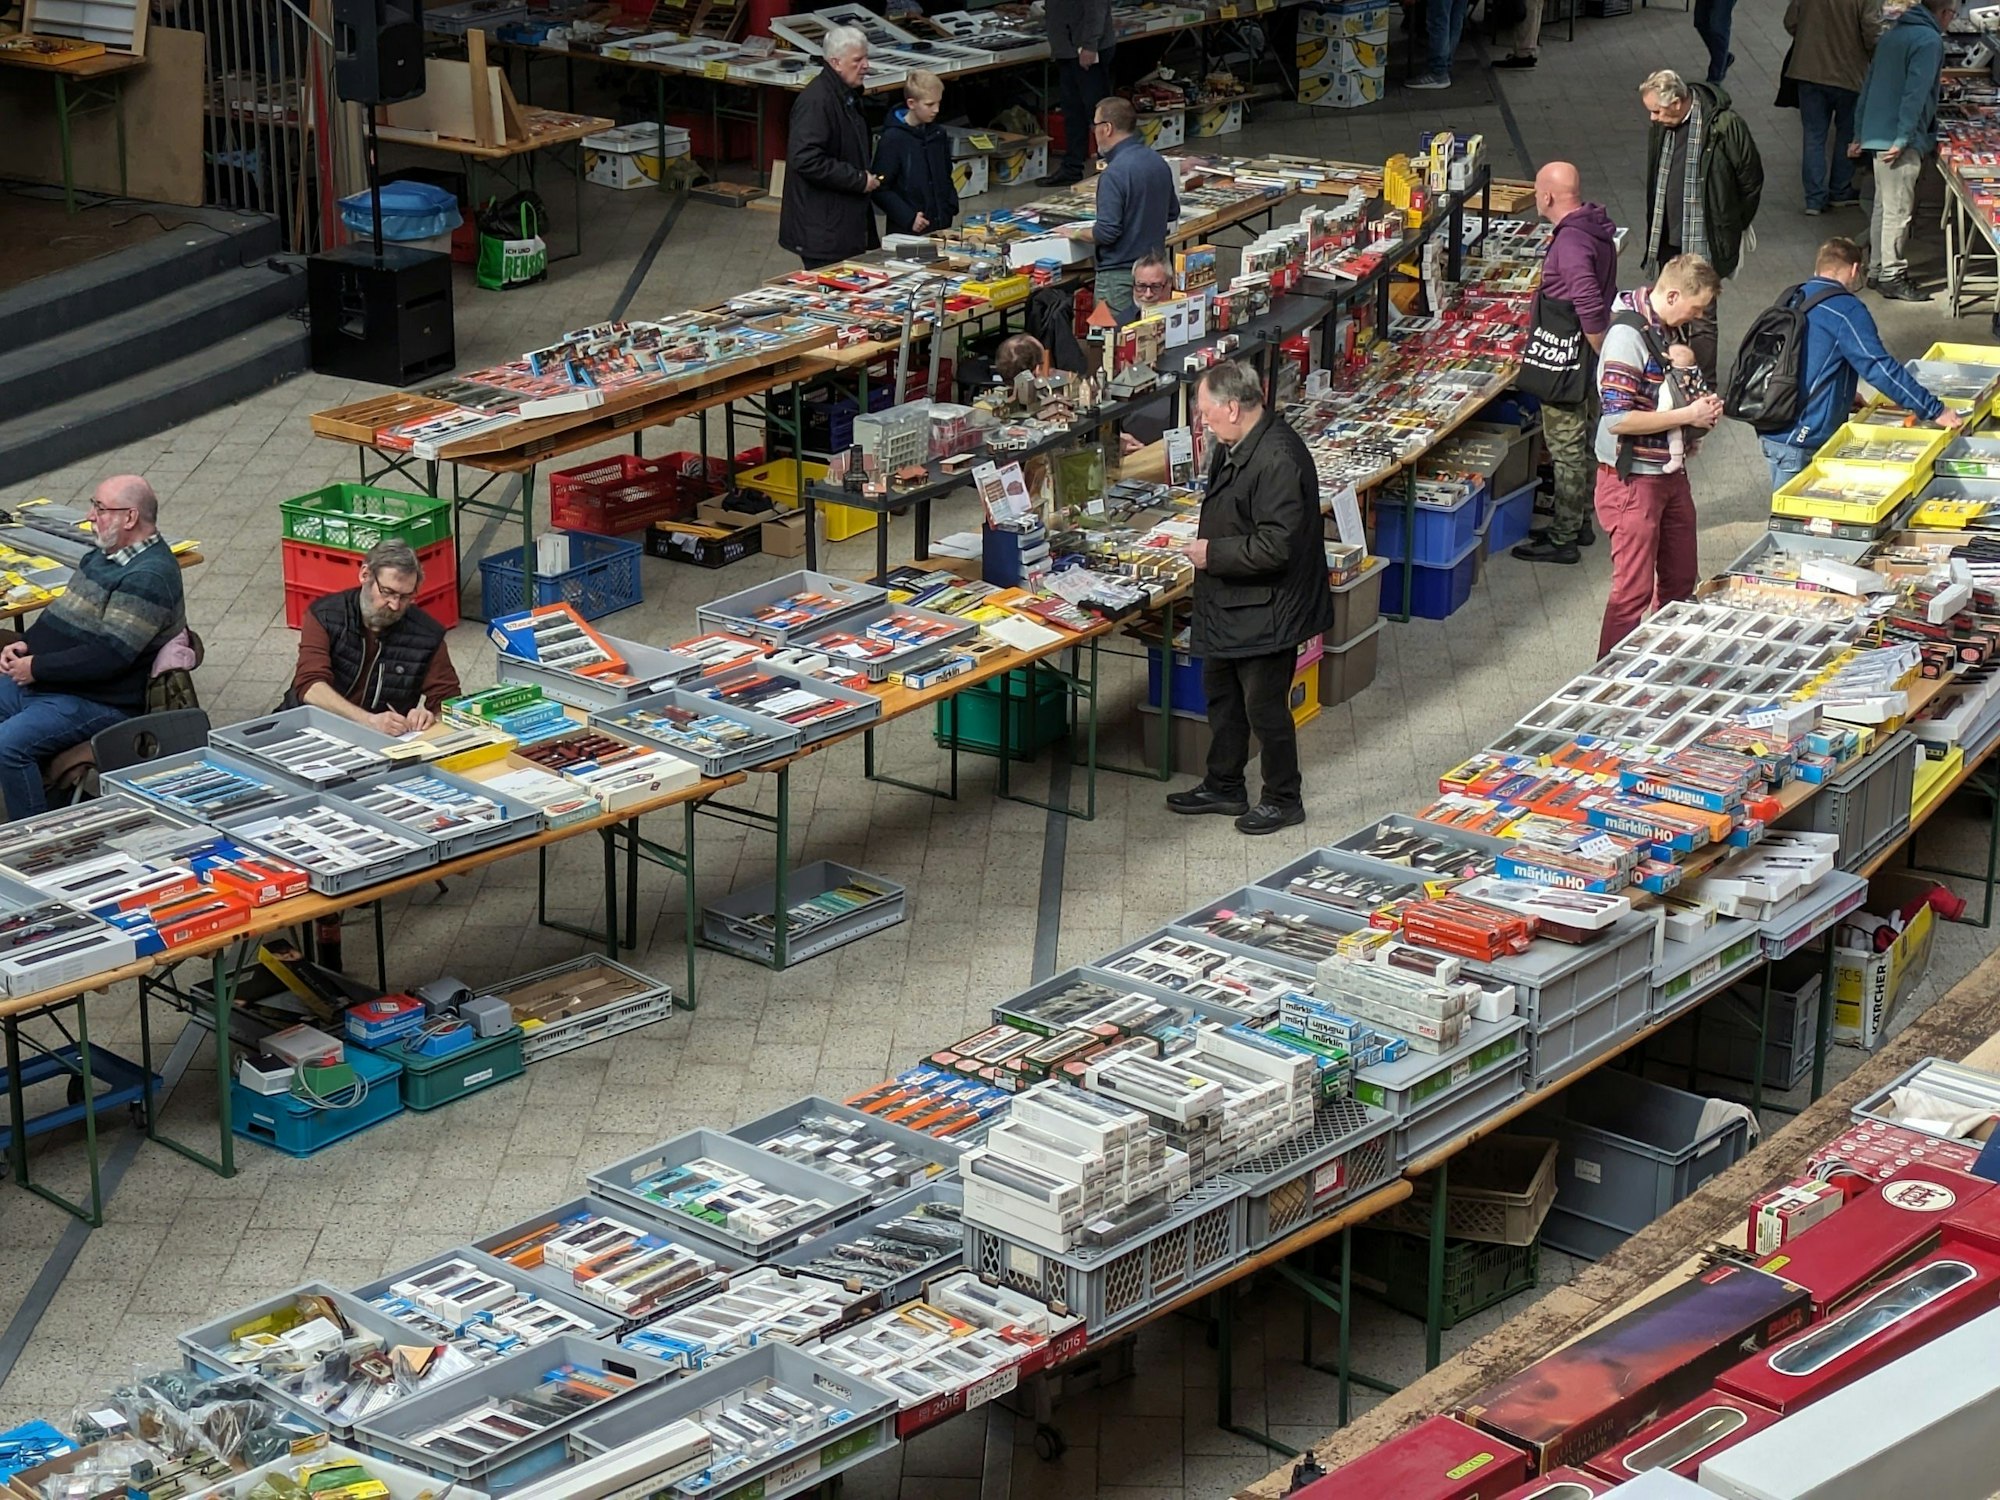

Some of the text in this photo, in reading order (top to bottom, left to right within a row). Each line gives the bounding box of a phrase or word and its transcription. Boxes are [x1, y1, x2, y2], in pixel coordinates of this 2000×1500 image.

[1655, 783, 1706, 806] märklin
[1604, 815, 1654, 839] märklin
[1513, 864, 1565, 887] märklin
[1312, 1020, 1345, 1036] märklin
[1418, 1025, 1438, 1037] PIKO
[1312, 1033, 1344, 1049] märklin
[1055, 1333, 1081, 1357] 2016
[932, 1391, 961, 1416] 2016
